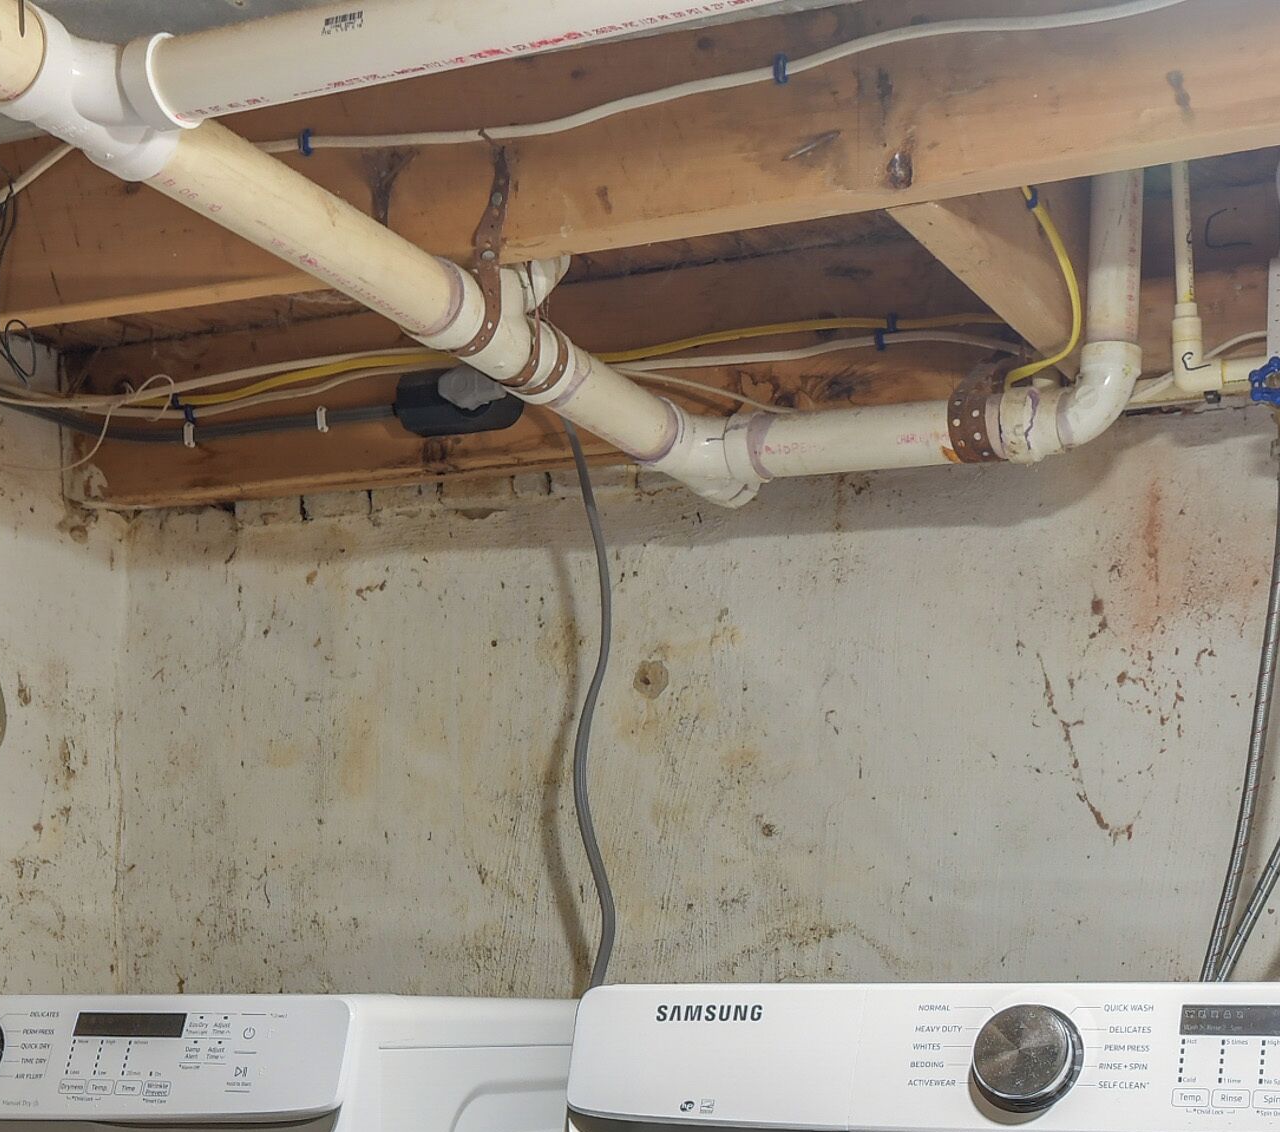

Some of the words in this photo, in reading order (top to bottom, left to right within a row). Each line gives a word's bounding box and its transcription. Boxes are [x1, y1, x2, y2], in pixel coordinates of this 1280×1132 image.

[918, 1004, 951, 1012] NORMAL
[1103, 1004, 1129, 1012] QUICK
[1130, 1004, 1154, 1012] WASH
[656, 1004, 764, 1022] SAMSUNG
[914, 1025, 940, 1033] HEAVY
[941, 1025, 962, 1033] DUTY
[1109, 1025, 1152, 1034] DELICATES
[912, 1042, 941, 1050] WHITES
[1104, 1044, 1126, 1052] PERM
[1126, 1044, 1151, 1052] PRESS
[909, 1060, 945, 1068] BEDDING
[1098, 1062, 1123, 1070] RINSE
[1129, 1062, 1148, 1070] SPIN
[907, 1079, 956, 1087] ACTIVEWEAR
[1098, 1080, 1118, 1089] SELF
[121, 1084, 136, 1092] Time
[1220, 1093, 1243, 1102] Rinse
